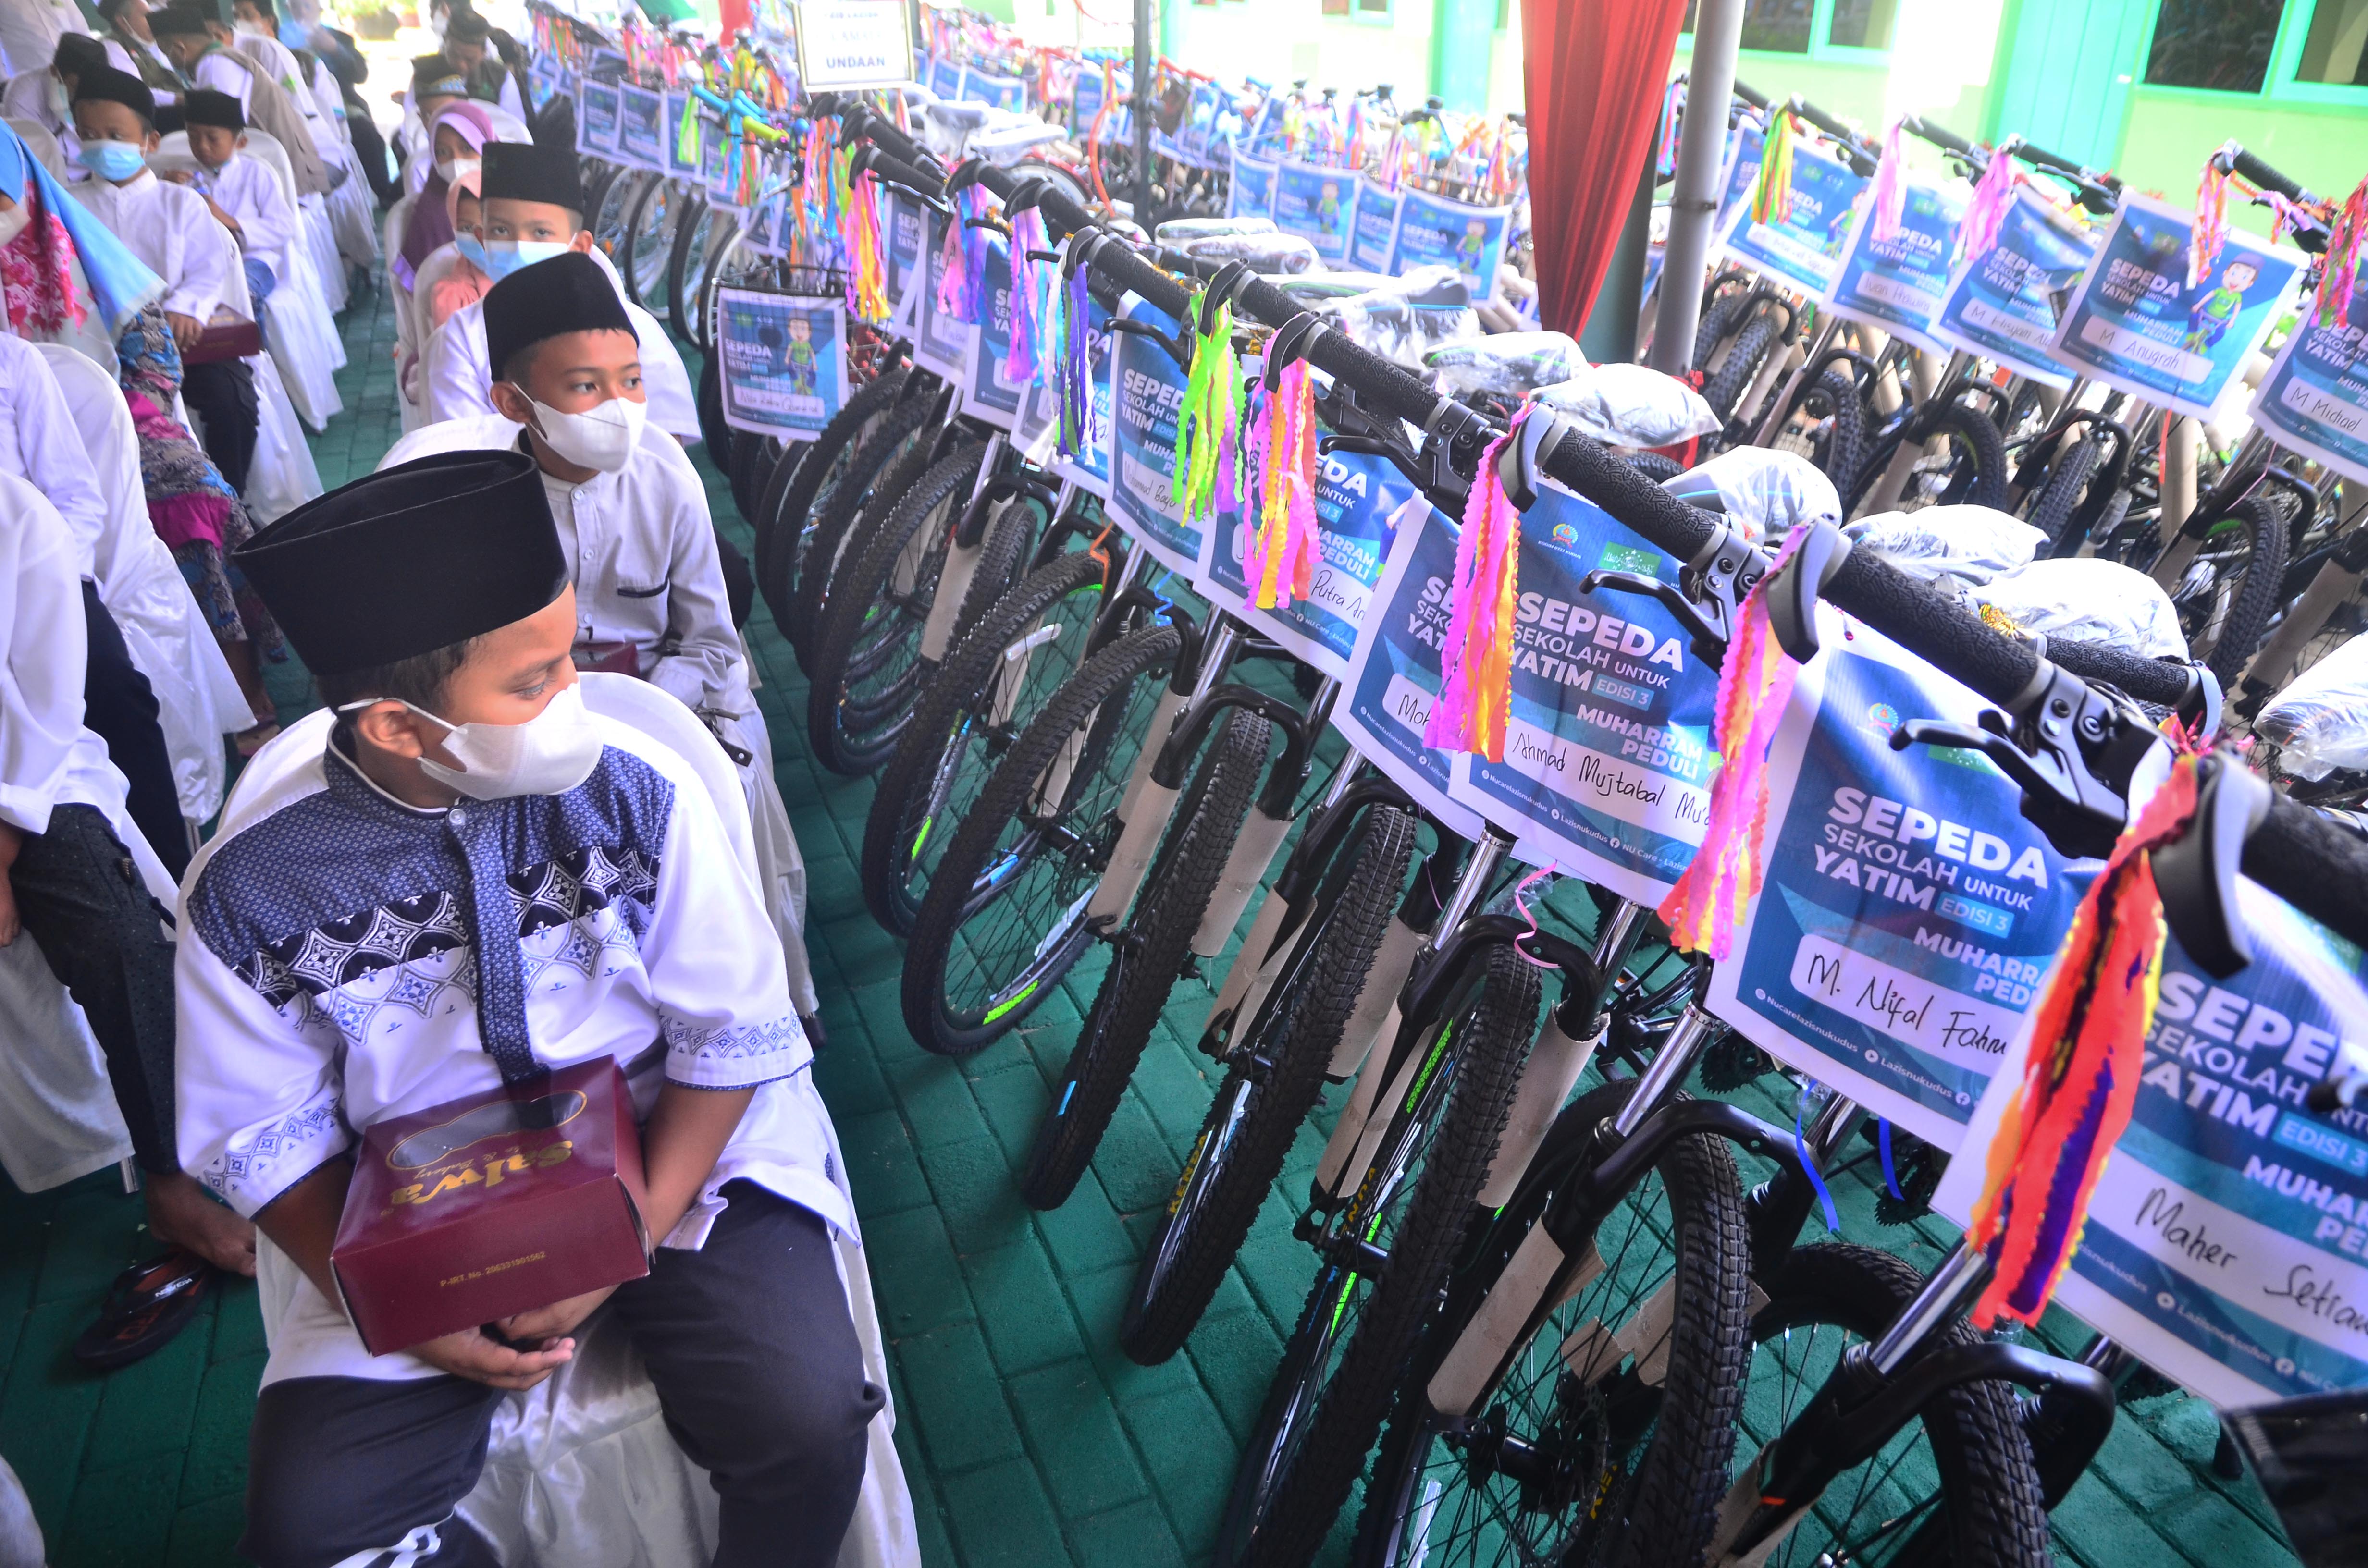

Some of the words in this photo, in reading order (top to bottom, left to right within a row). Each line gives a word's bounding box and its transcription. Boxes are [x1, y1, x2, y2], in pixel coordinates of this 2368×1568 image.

[826, 56, 885, 68] UNDAAN
[1869, 241, 1907, 262] YATIM
[1983, 267, 2022, 294] YATIM
[2101, 281, 2137, 306] YATIM
[2107, 272, 2145, 295] SEKOLAH
[2145, 292, 2171, 305] UNTUK
[2110, 258, 2181, 299] SEPEDA
[1971, 305, 1986, 321] M
[2124, 309, 2184, 338] MUHARRAM
[725, 337, 773, 359] SEPEDA
[2099, 328, 2116, 345] M
[2123, 340, 2180, 370] Anugrah
[2142, 324, 2180, 345] PEDULI
[2313, 329, 2366, 360] SEKOLAH
[727, 357, 751, 371] YATIM
[2305, 338, 2354, 371] YATIM
[1121, 402, 1155, 432] YATIM
[1155, 423, 1176, 437] EDISI
[1122, 389, 1165, 418] SEKOLAH
[2290, 386, 2310, 408] M
[2311, 399, 2362, 432] Michael
[1317, 485, 1357, 510] UNTUK
[1330, 506, 1340, 518] 3
[1320, 545, 1370, 581] PEDULI
[1311, 569, 1345, 606] Putra
[1515, 591, 1684, 673] SEPEDA
[1510, 645, 1594, 692] YATIM
[1596, 679, 1636, 701] EDISI
[1638, 692, 1650, 706] 3
[1514, 624, 1611, 669] SEKOLAH
[1614, 661, 1671, 690] UNTUK
[1366, 711, 1417, 757] Nucarelazisnukudus
[1576, 704, 1703, 763] MUHARRAM
[1512, 732, 1567, 772] Ahmad
[1579, 754, 1666, 807] Mujtabal
[1621, 739, 1700, 780] PEDULI
[1490, 774, 1549, 813] Nucarelazisnukudus
[1560, 814, 1608, 843] Lazisnukudus
[1622, 844, 1636, 854] NU
[1637, 850, 1658, 863] Care
[1827, 786, 2048, 890] SEPEDA
[1824, 823, 1959, 886] SEKOLAH
[1964, 876, 2033, 911] UNTUK
[1814, 844, 1936, 911] YATIM
[1939, 896, 1993, 928] EDISI
[1995, 915, 2008, 931] 3
[1807, 954, 1841, 996] M.
[1973, 970, 2036, 1007] PED
[1767, 996, 1859, 1053] Nucarelazisnukudus
[1881, 1057, 1953, 1098] Lazisnukudus
[2279, 1119, 2349, 1162] EDISI
[2349, 1147, 2368, 1169] 3
[413, 1158, 474, 1180] Bakery
[1168, 1134, 1208, 1214] KENDA
[2135, 1187, 2238, 1268] Maher
